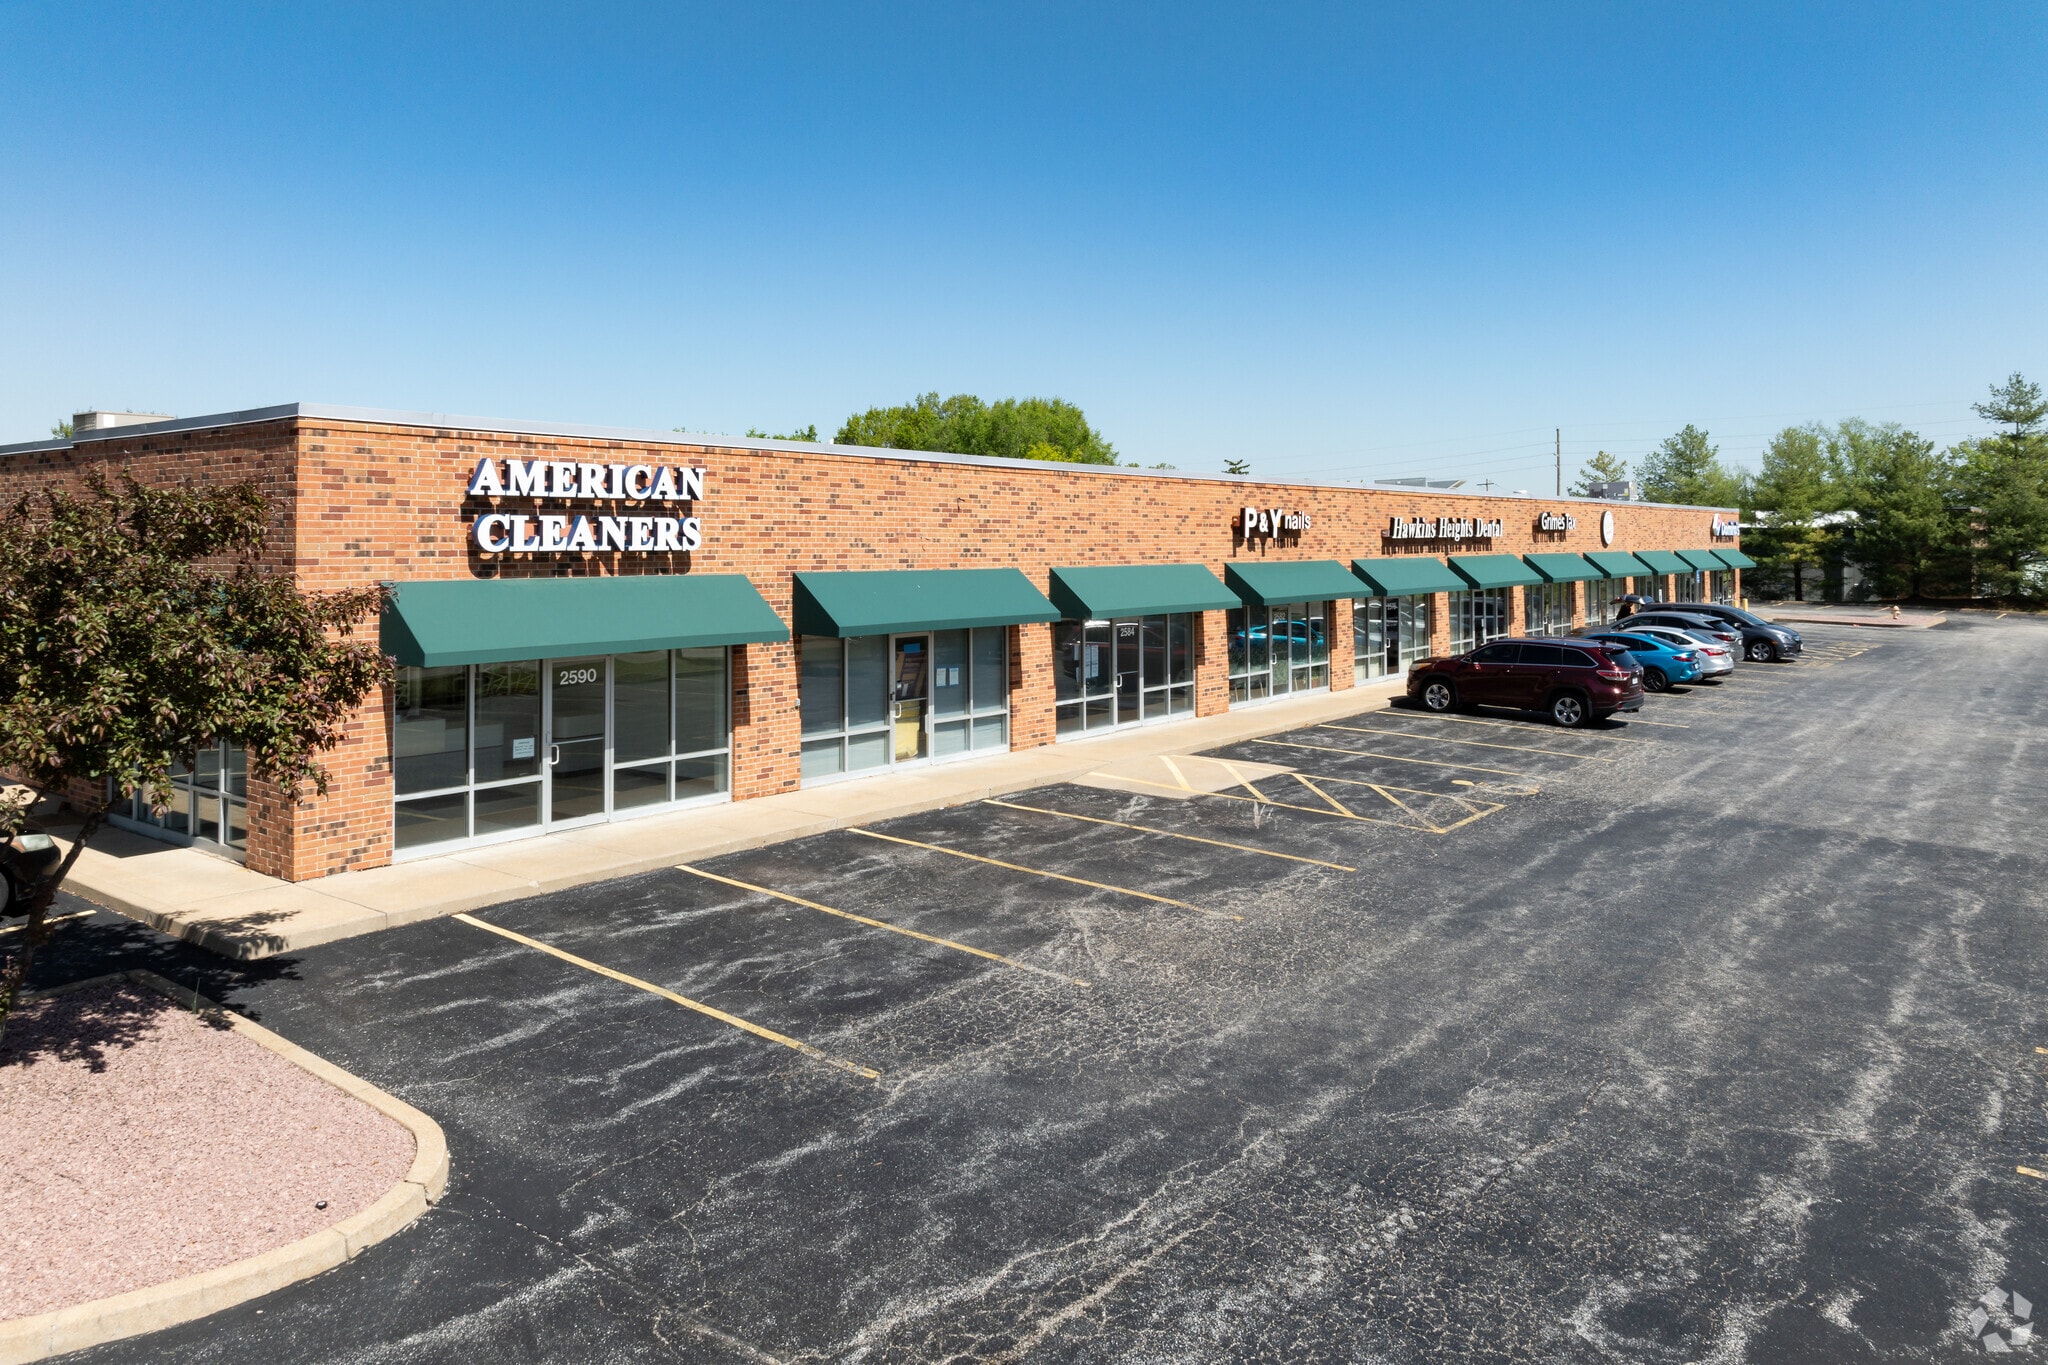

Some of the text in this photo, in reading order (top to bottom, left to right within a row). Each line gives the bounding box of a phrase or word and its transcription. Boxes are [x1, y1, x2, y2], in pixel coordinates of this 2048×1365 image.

[467, 457, 707, 500] AMERICAN
[1284, 511, 1311, 530] nails
[1392, 517, 1504, 541] Hawkins Heights Dental
[1541, 511, 1577, 530] Grimes Tax
[472, 513, 702, 552] CLEANERS
[1120, 626, 1135, 637] 2584
[560, 668, 597, 685] 2590
